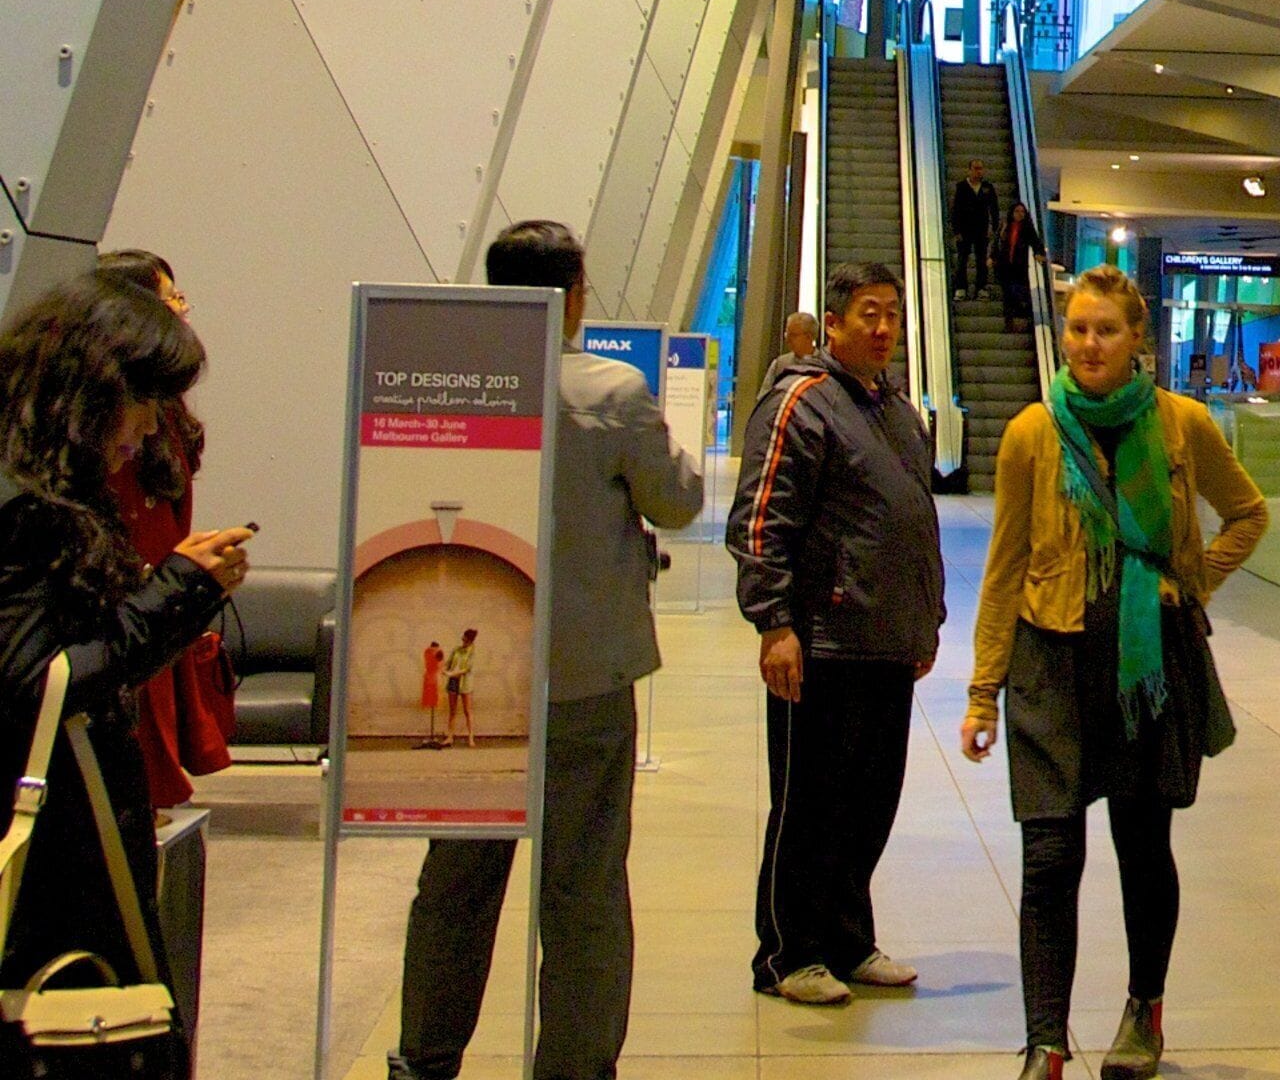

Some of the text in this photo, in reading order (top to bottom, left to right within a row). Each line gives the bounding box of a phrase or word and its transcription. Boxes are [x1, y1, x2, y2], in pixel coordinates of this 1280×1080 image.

[1165, 255, 1243, 265] CHILDREN'S GALLERY
[587, 339, 632, 351] IMAX
[375, 371, 519, 389] TOP DESIGNS 2013
[417, 391, 471, 413] problem
[440, 419, 467, 430] June
[372, 431, 468, 444] Melbourne Gallery
